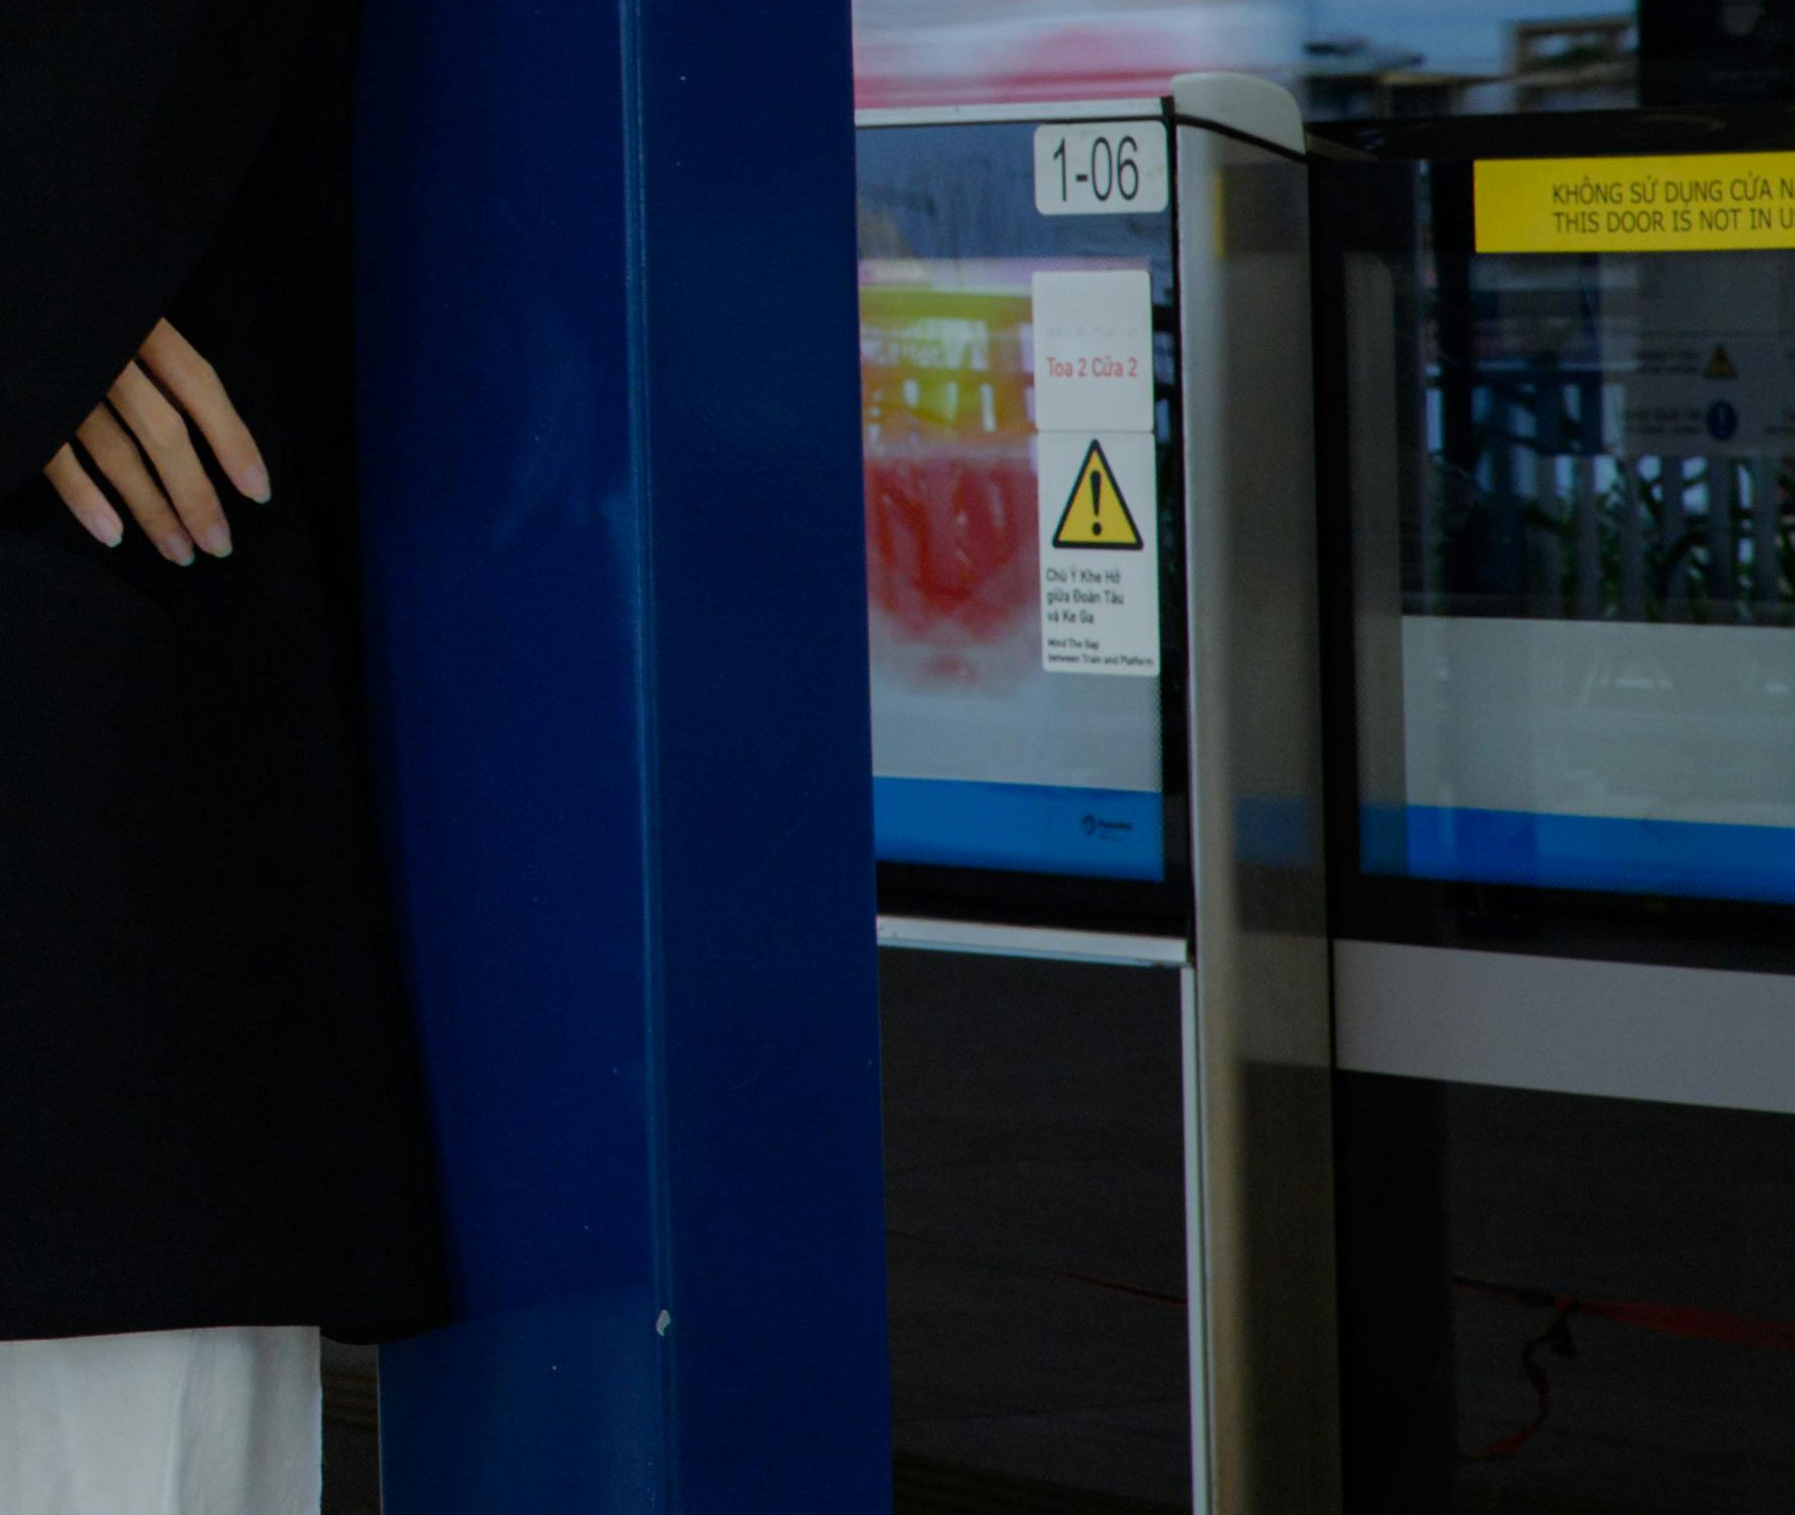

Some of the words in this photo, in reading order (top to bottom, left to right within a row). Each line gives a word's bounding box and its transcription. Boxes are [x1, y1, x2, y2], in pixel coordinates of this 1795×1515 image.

[1053, 135, 1139, 202] 1-06
[1552, 176, 1623, 205] KHÔNG
[1630, 174, 1658, 204] SỬ
[1665, 180, 1723, 208] DỤNG
[1729, 171, 1773, 201] CỬA
[1553, 211, 1599, 234] THIS
[1607, 210, 1664, 233] DOOR
[1672, 209, 1692, 232] IS
[1700, 208, 1742, 231] NOT
[1750, 208, 1772, 230] IN
[1047, 356, 1074, 377] Toa
[1078, 357, 1087, 377] 2
[1092, 354, 1124, 377] Cửa
[1128, 356, 1137, 377] 2
